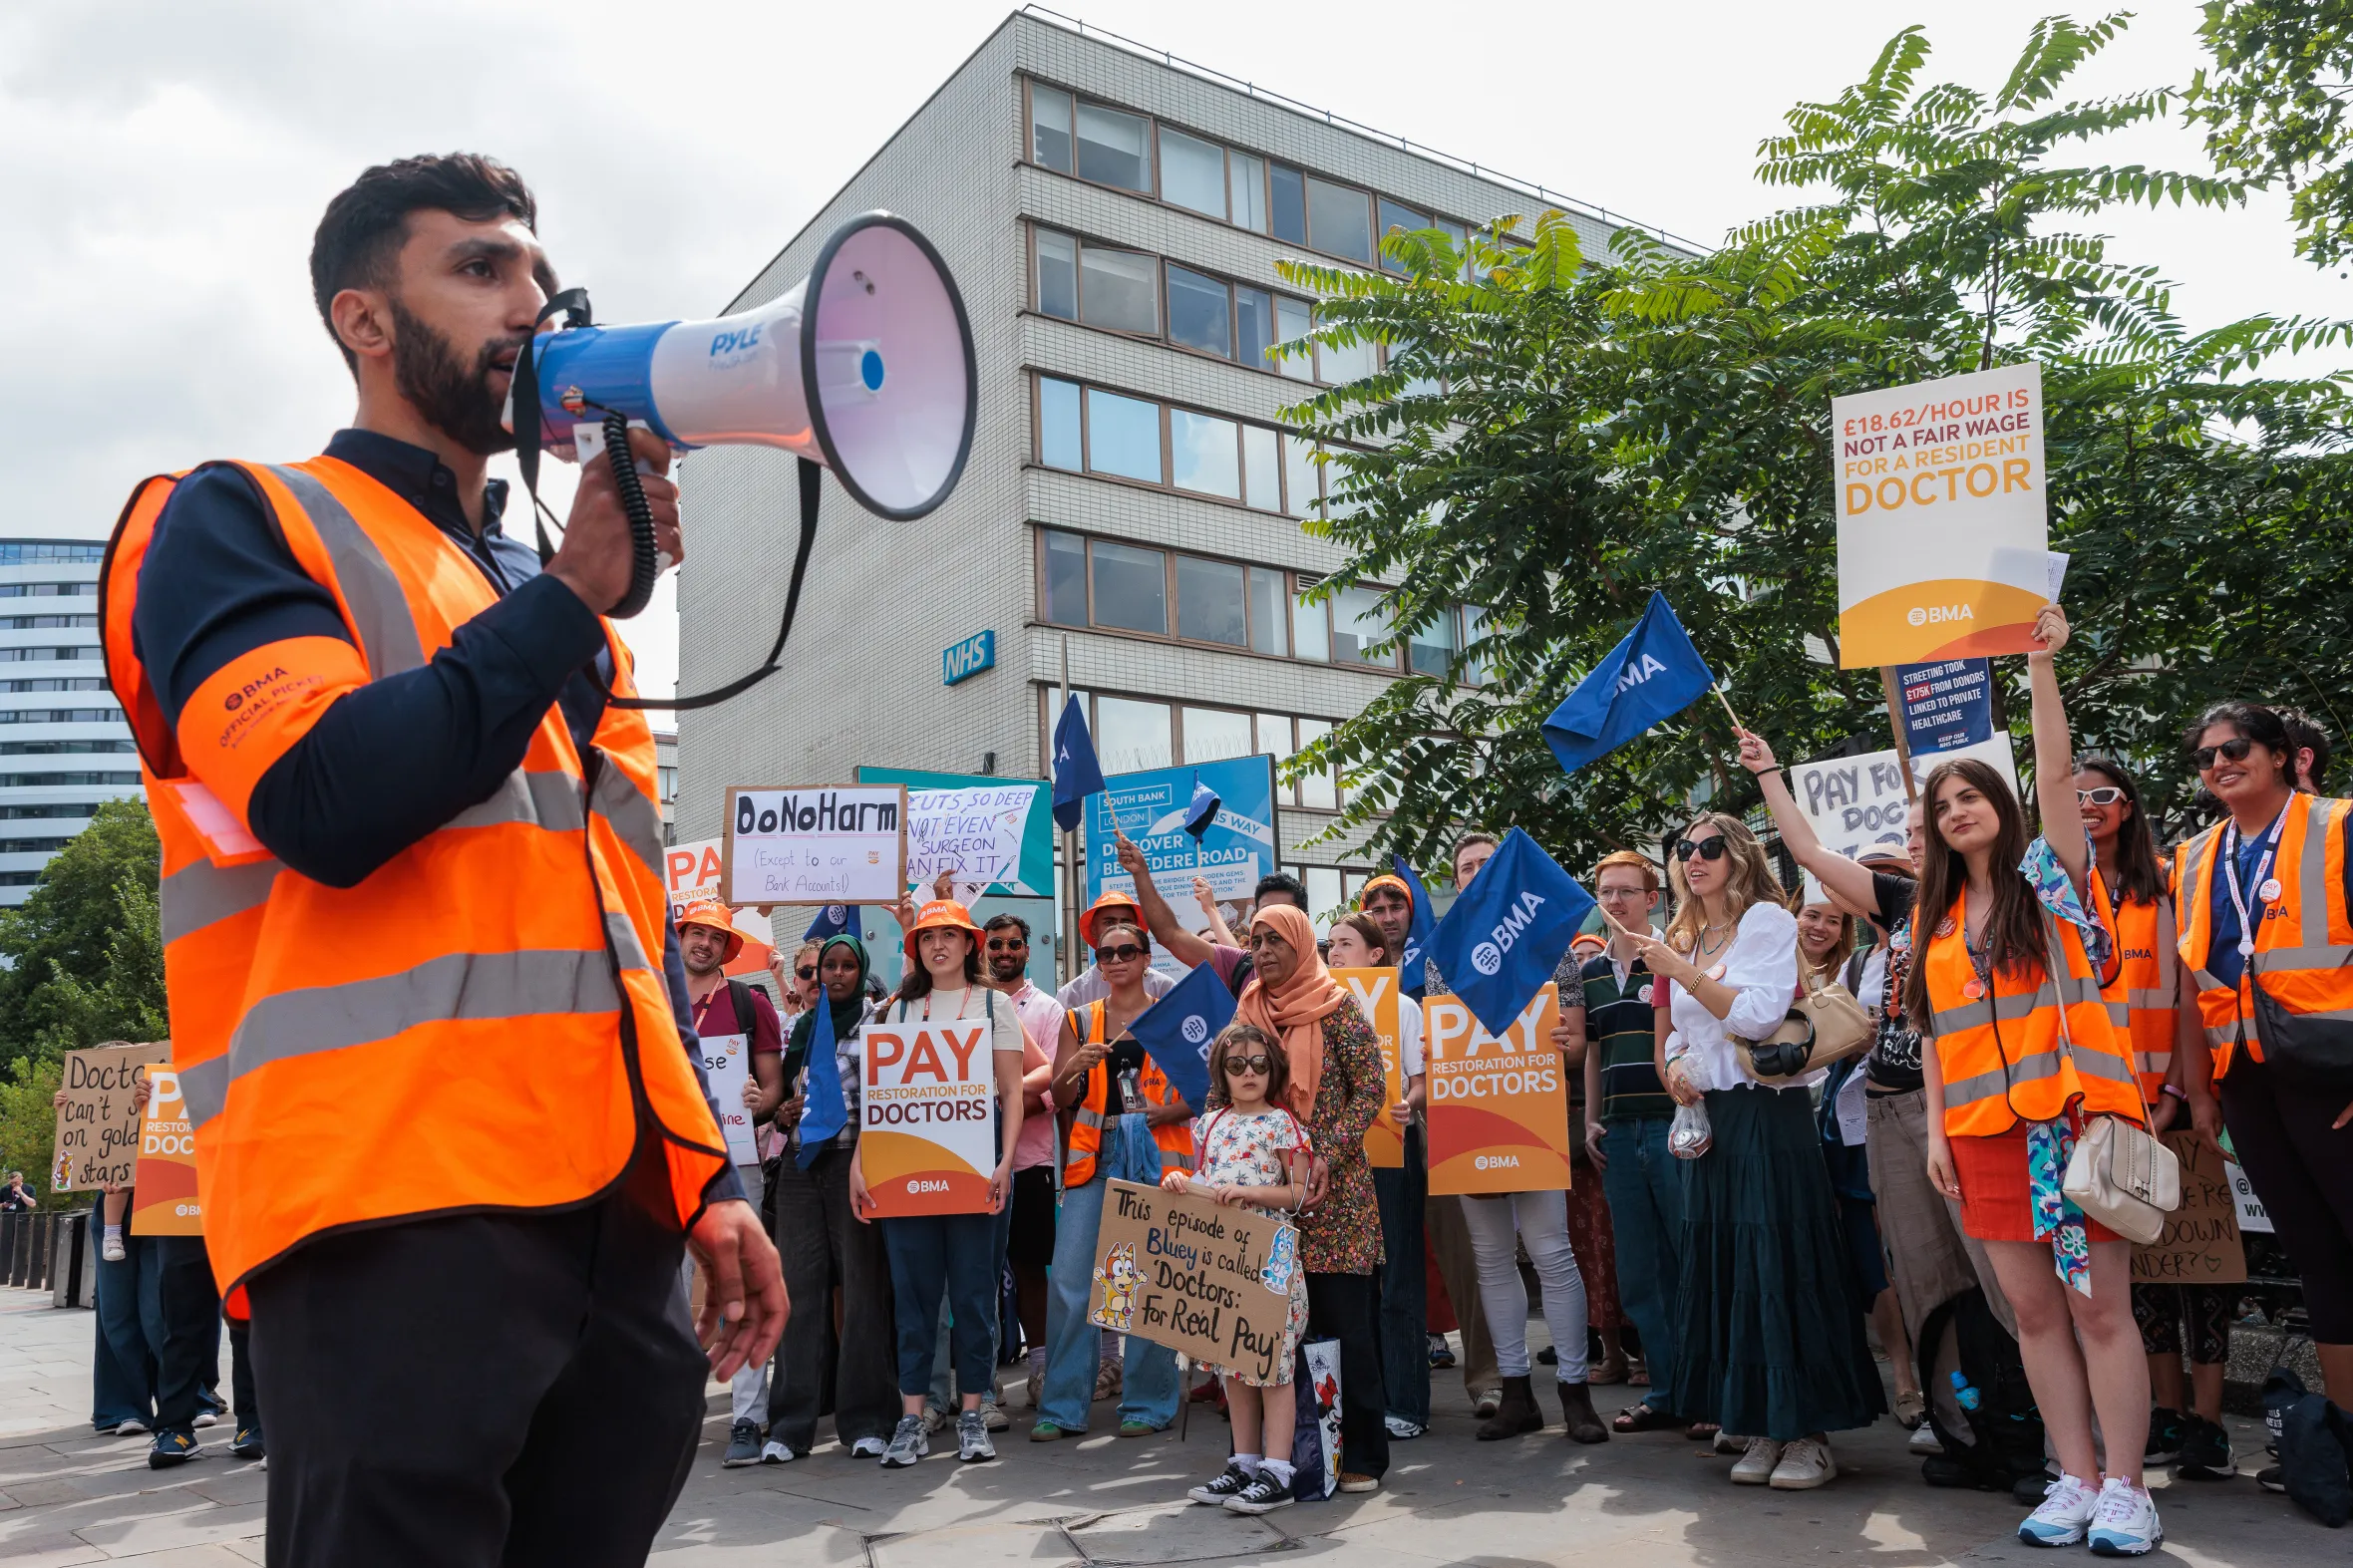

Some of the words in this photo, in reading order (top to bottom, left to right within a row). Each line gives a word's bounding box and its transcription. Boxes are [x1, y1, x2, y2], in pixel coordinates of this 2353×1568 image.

[710, 322, 765, 357] PYLE
[1844, 394, 2001, 437] £18.62/HOUR
[2007, 389, 2029, 409] IS
[1845, 435, 1887, 458] NOT
[1892, 433, 1908, 451] A
[1913, 424, 1960, 447] FAIR
[1965, 412, 2031, 438] WAGE
[1846, 457, 1888, 478] FOR
[1893, 454, 1909, 471] A
[1915, 434, 2031, 469] RESIDENT
[1846, 458, 2032, 516] DOCTOR
[1928, 603, 1974, 623] BMA
[945, 634, 985, 681] NHS
[242, 667, 289, 698] BMA
[1614, 653, 1667, 697] MA
[1903, 665, 1944, 686] STREETING
[1944, 659, 1966, 675] TOOK
[1906, 685, 1931, 701] £175K
[1930, 681, 1953, 695] FROM
[1954, 671, 1986, 691] DONORS
[1909, 700, 1936, 716] LINKED
[1937, 697, 1948, 708] TO
[1950, 688, 1982, 706] PRIVATE
[219, 698, 271, 748] OFFICIAL
[1911, 709, 1963, 731] HEALTHCARE
[1938, 735, 1952, 744] KEEP
[1952, 737, 1969, 747] PUBLIC
[967, 792, 990, 807] SO
[994, 791, 1033, 806] DEEP
[1103, 794, 1138, 806] SOUTH
[1138, 790, 1166, 802] BANK
[1803, 765, 1858, 816] PAY
[907, 817, 941, 837] NOT
[944, 815, 995, 835] EVEN
[1104, 813, 1145, 826] LONDON
[1231, 816, 1261, 835] WAY
[806, 848, 819, 866] to
[831, 856, 847, 866] our
[919, 837, 996, 855] SURGEON
[1103, 835, 1183, 856] DIOVER
[1200, 847, 1246, 865] ROAD
[667, 845, 722, 891] PA
[907, 857, 932, 875] AN
[937, 857, 968, 875] FIX
[975, 855, 1000, 873] IT
[671, 888, 718, 902] RESTORA
[765, 874, 789, 892] Bank
[927, 906, 948, 915] BMA
[1492, 891, 1545, 954] BMA
[2266, 905, 2288, 920] BA
[2124, 948, 2153, 960] BMA
[1430, 994, 1550, 1060] PAY
[866, 1028, 984, 1087] PAY
[1433, 1056, 1524, 1075] RESTORATION
[1528, 1053, 1555, 1067] FOR
[867, 1086, 957, 1101] RESTORATION
[960, 1084, 986, 1097] FOR
[1433, 1070, 1557, 1100] DOCTORS
[66, 1095, 111, 1123] can't
[868, 1098, 987, 1125] DOCTORS
[64, 1127, 87, 1147] on
[99, 1117, 141, 1158] gold
[146, 1121, 193, 1132] RESTOR
[80, 1156, 131, 1184] stars
[1490, 1155, 1519, 1168] BMA
[920, 1179, 950, 1192] BMA
[1113, 1188, 1152, 1221] This
[1168, 1209, 1224, 1239] episode
[1233, 1229, 1251, 1254] of
[2162, 1217, 2233, 1246] DOWN
[1146, 1227, 1197, 1271] Bluey
[1201, 1246, 1212, 1266] is
[1217, 1253, 1262, 1285] called
[2131, 1252, 2198, 1278] NDER?
[1142, 1294, 1169, 1327] For
[1171, 1298, 1220, 1344] Real
